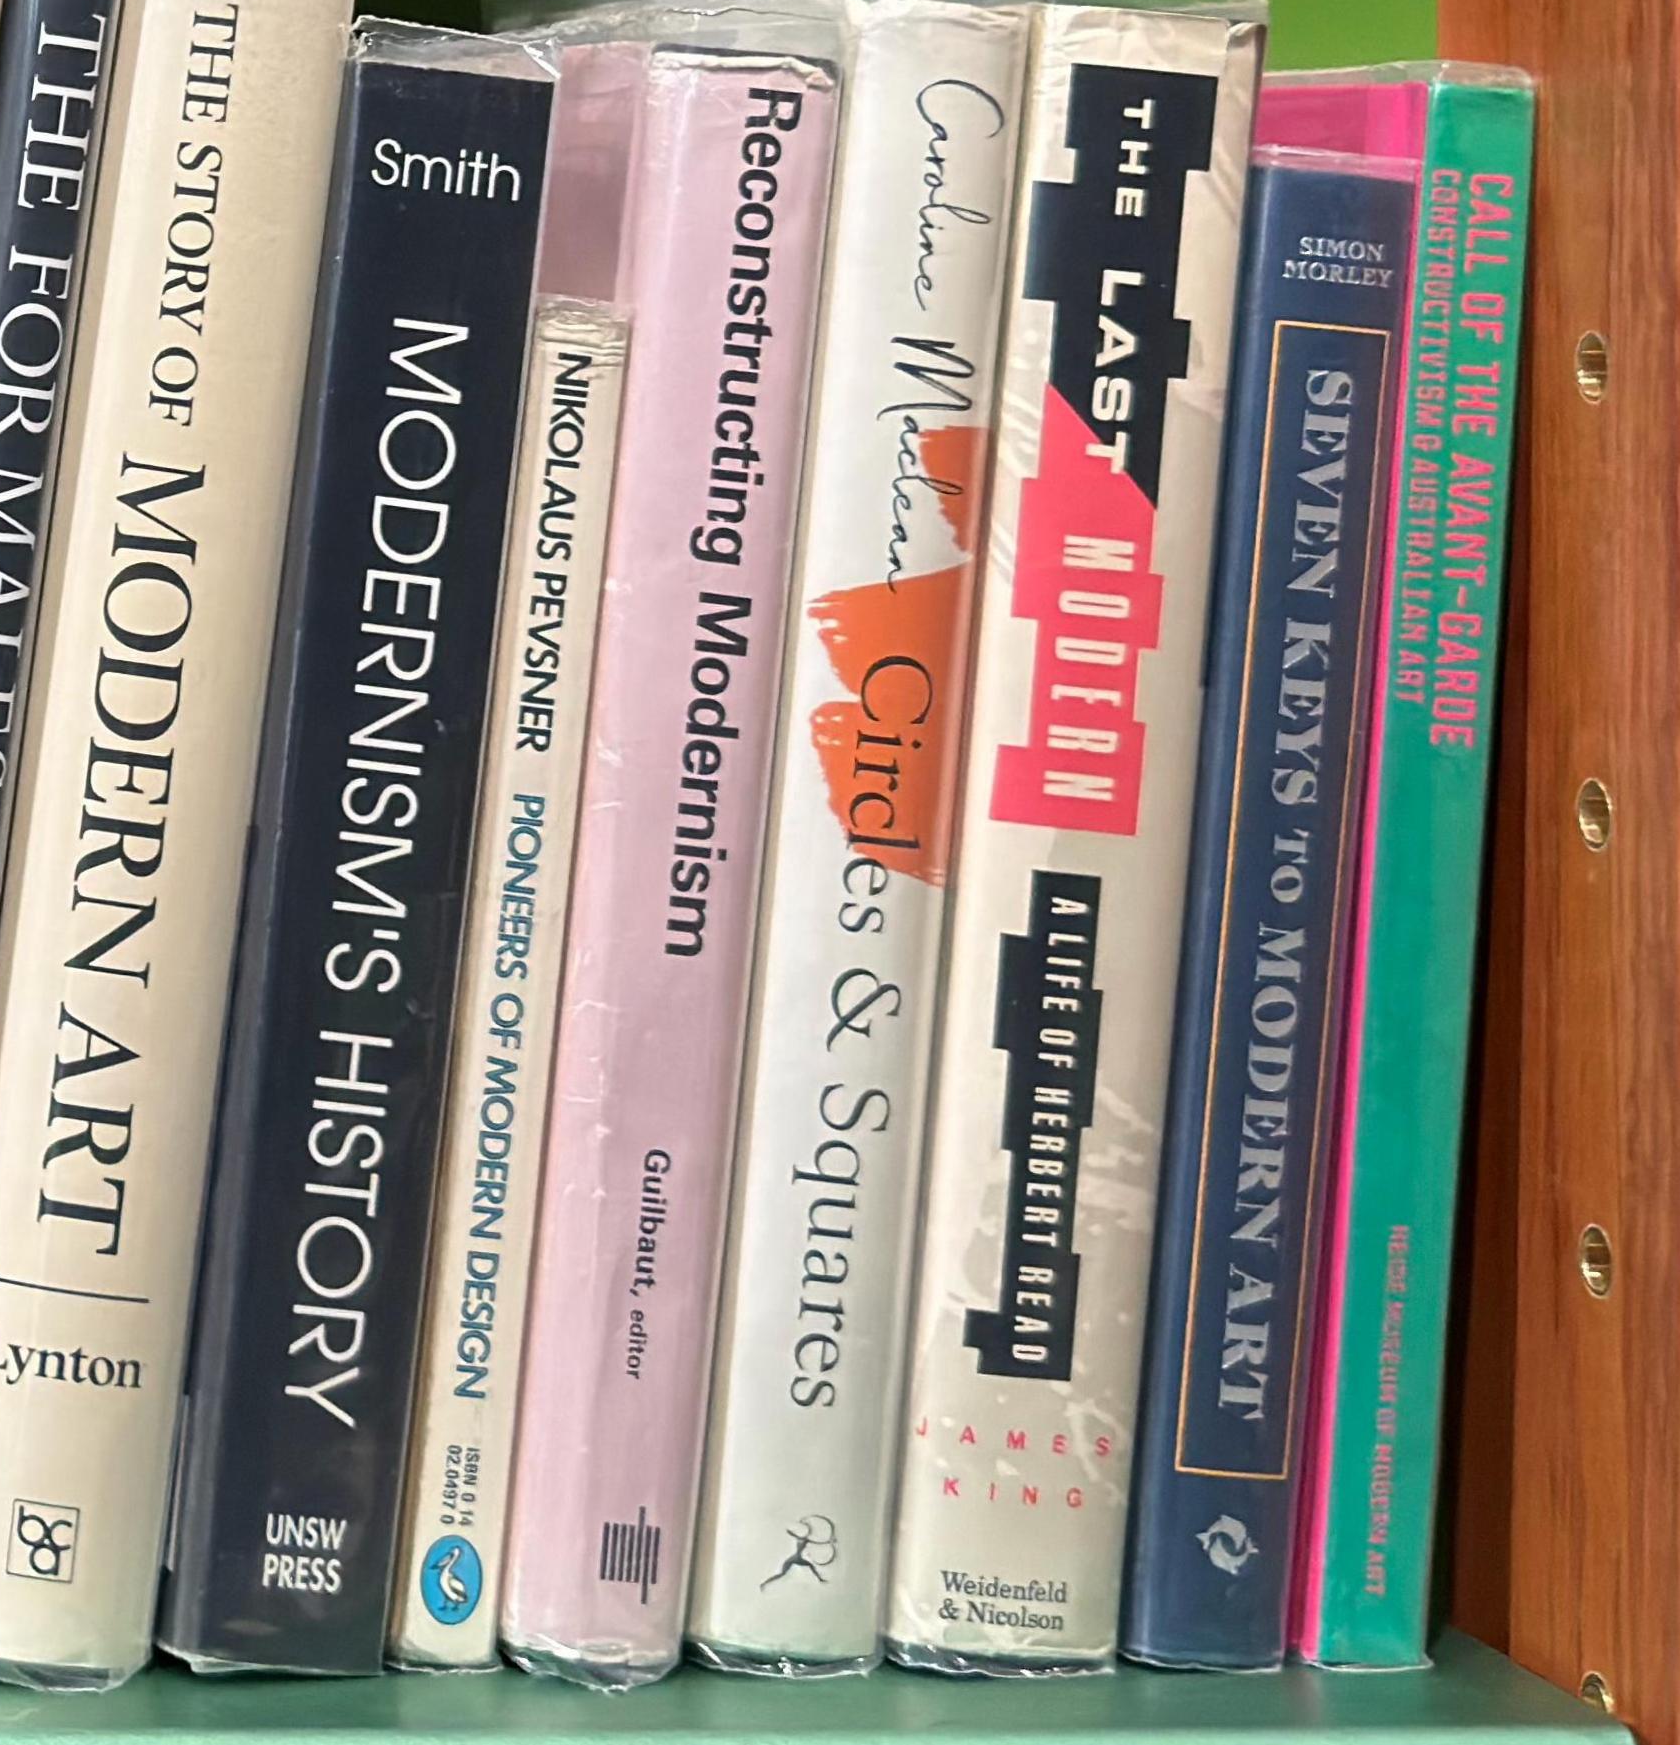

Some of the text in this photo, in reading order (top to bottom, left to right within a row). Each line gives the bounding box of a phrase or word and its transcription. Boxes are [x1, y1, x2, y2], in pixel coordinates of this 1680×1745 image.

[18, 14, 105, 210] THE
[371, 138, 520, 201] Smith
[1282, 260, 1393, 288] MORLEY
[1299, 236, 1384, 262] SIMON
[1042, 98, 1154, 800] THE LAST MODERN
[1430, 173, 1514, 748] CALL OF THE AVANT-GARDE
[663, 86, 802, 957] Reconstructing Modernism
[37, 5, 238, 1256] THE STORY OF MODERN ART
[284, 318, 469, 1428] MODERNISM'S HISTORY
[453, 352, 591, 1399] NIKOLAUS PEVSNER PIONEERS OF MODERN DESIGN
[790, 656, 934, 1408] Circles & Squares
[625, 1149, 671, 1379] Guilbaut, editor
[915, 1416, 1112, 1456] JAMES
[943, 1477, 1083, 1508] KING
[261, 1554, 340, 1594] PRESS
[265, 1513, 346, 1550] UNSW
[941, 1570, 1067, 1603] Weidenfeld
[939, 1599, 1064, 1631] & Nicolson
